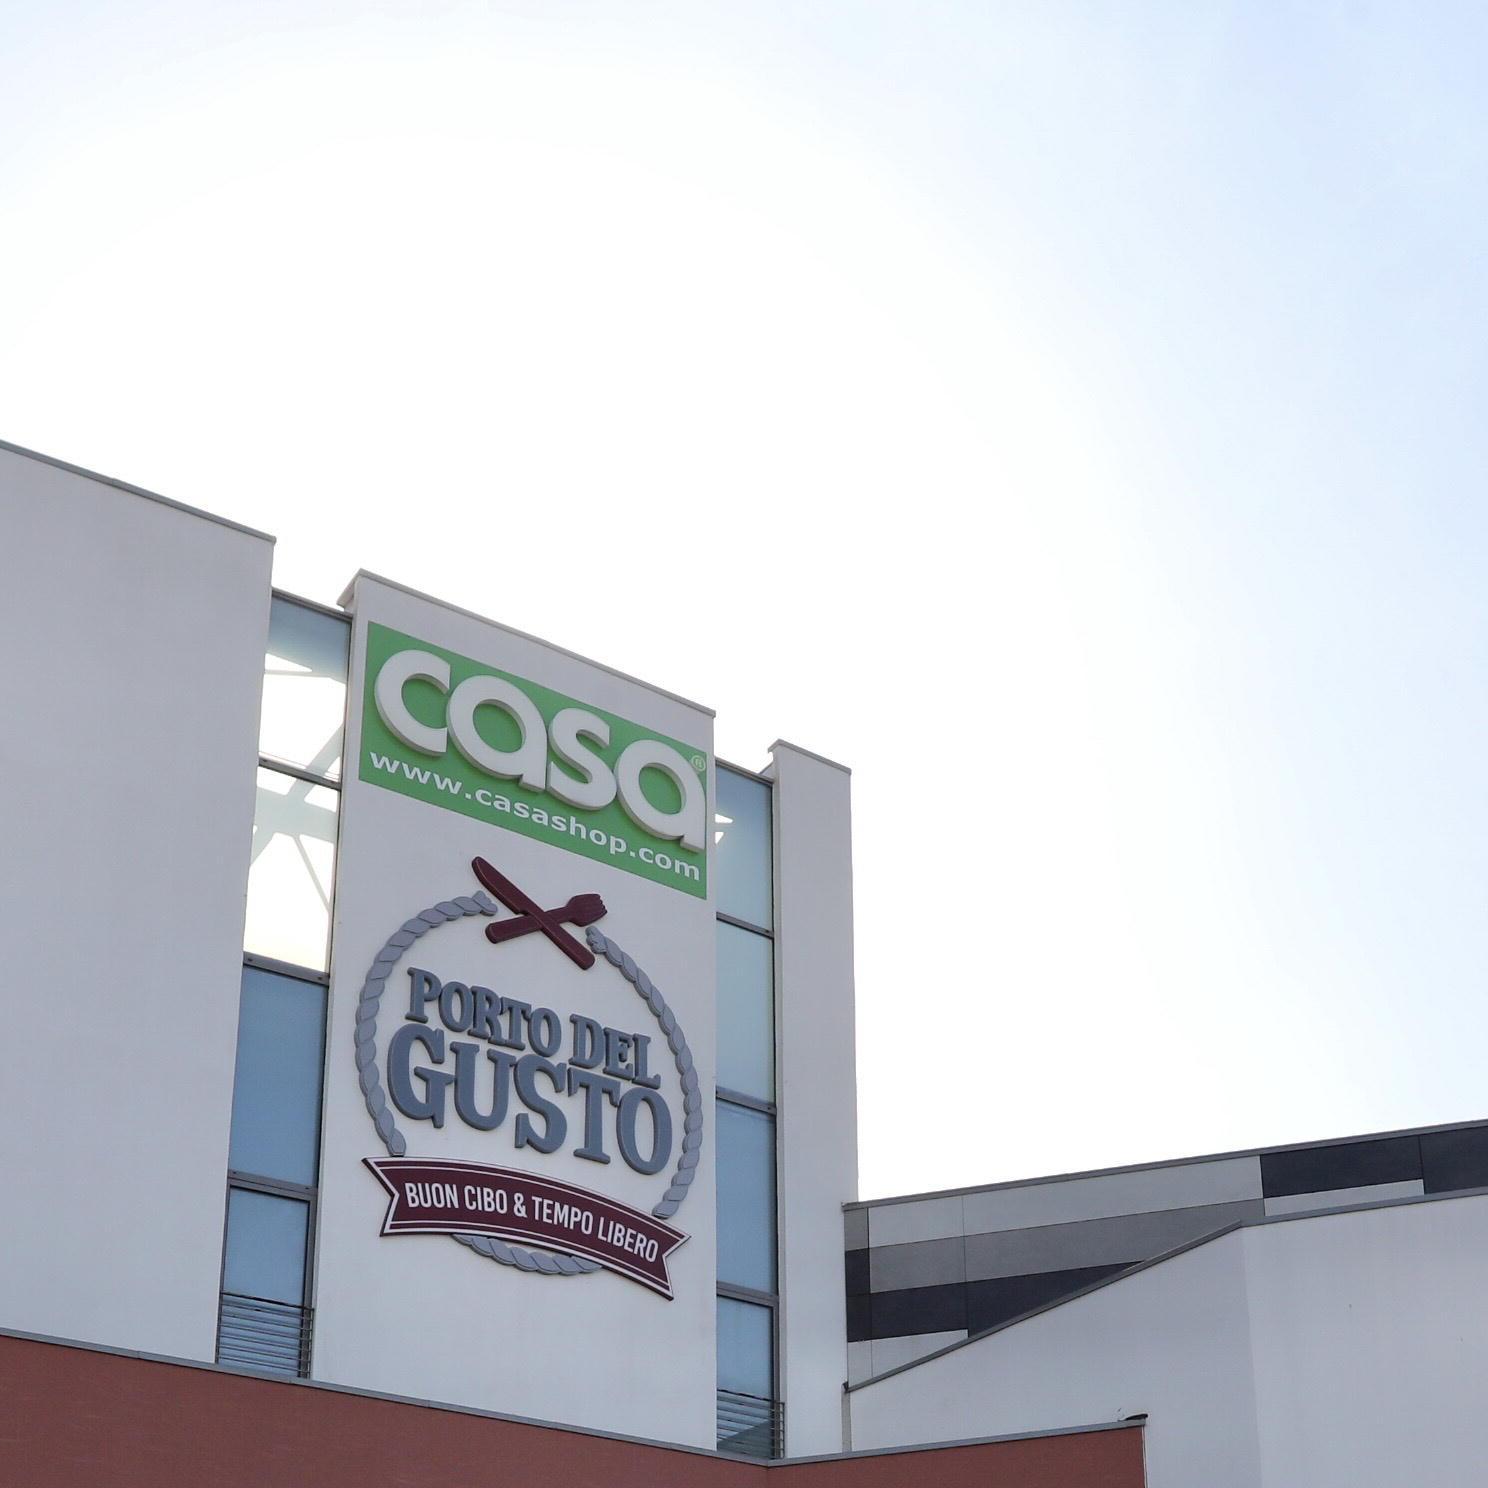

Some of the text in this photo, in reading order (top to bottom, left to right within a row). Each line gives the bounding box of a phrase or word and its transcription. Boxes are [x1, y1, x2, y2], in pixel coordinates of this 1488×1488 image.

[373, 649, 707, 852] casa
[369, 752, 702, 882] www.casashop.com
[407, 967, 661, 1089] PORTO DEL
[387, 1023, 673, 1176] GUSTO
[406, 1181, 660, 1263] BUON CIBO & TEMPO LIBERO
